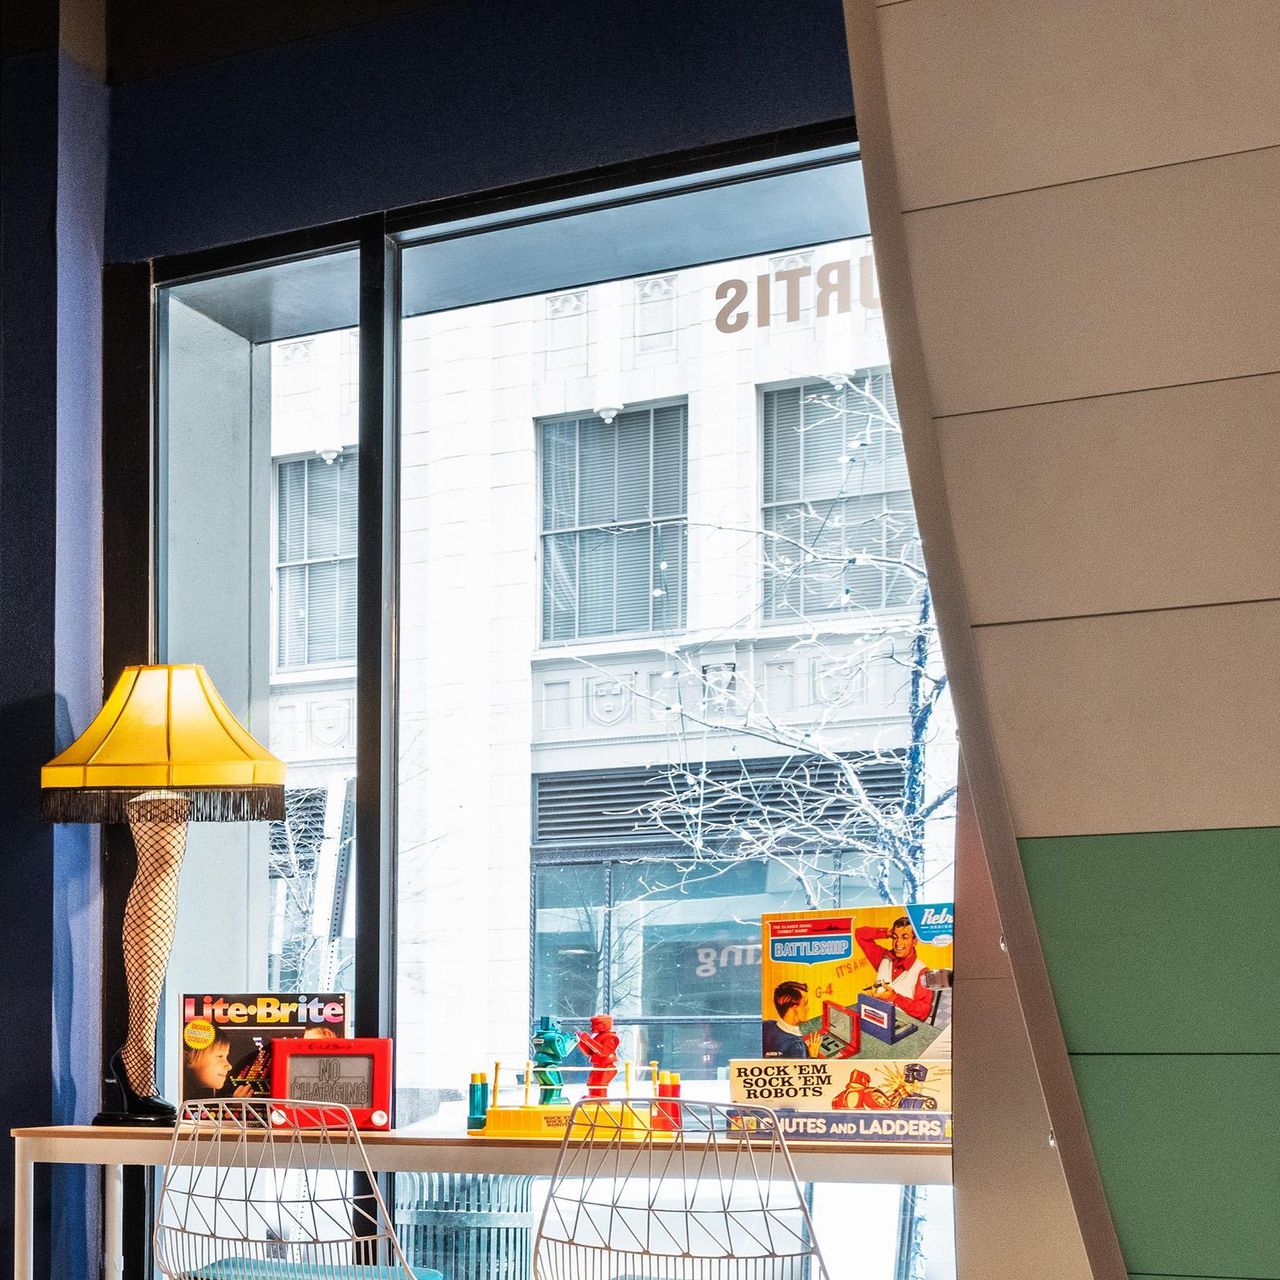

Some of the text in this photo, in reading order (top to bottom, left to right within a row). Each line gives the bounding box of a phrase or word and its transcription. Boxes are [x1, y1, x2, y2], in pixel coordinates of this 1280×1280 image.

[774, 940, 849, 957] BATTLESHIP
[318, 1058, 341, 1081] NO
[736, 1064, 828, 1078] ROCK 'EM
[743, 1075, 833, 1088] SOCK 'EM
[290, 1081, 369, 1105] CHARGING
[746, 1086, 823, 1099] ROBOTS
[829, 1122, 857, 1134] AND
[859, 1119, 941, 1137] LADDERS
